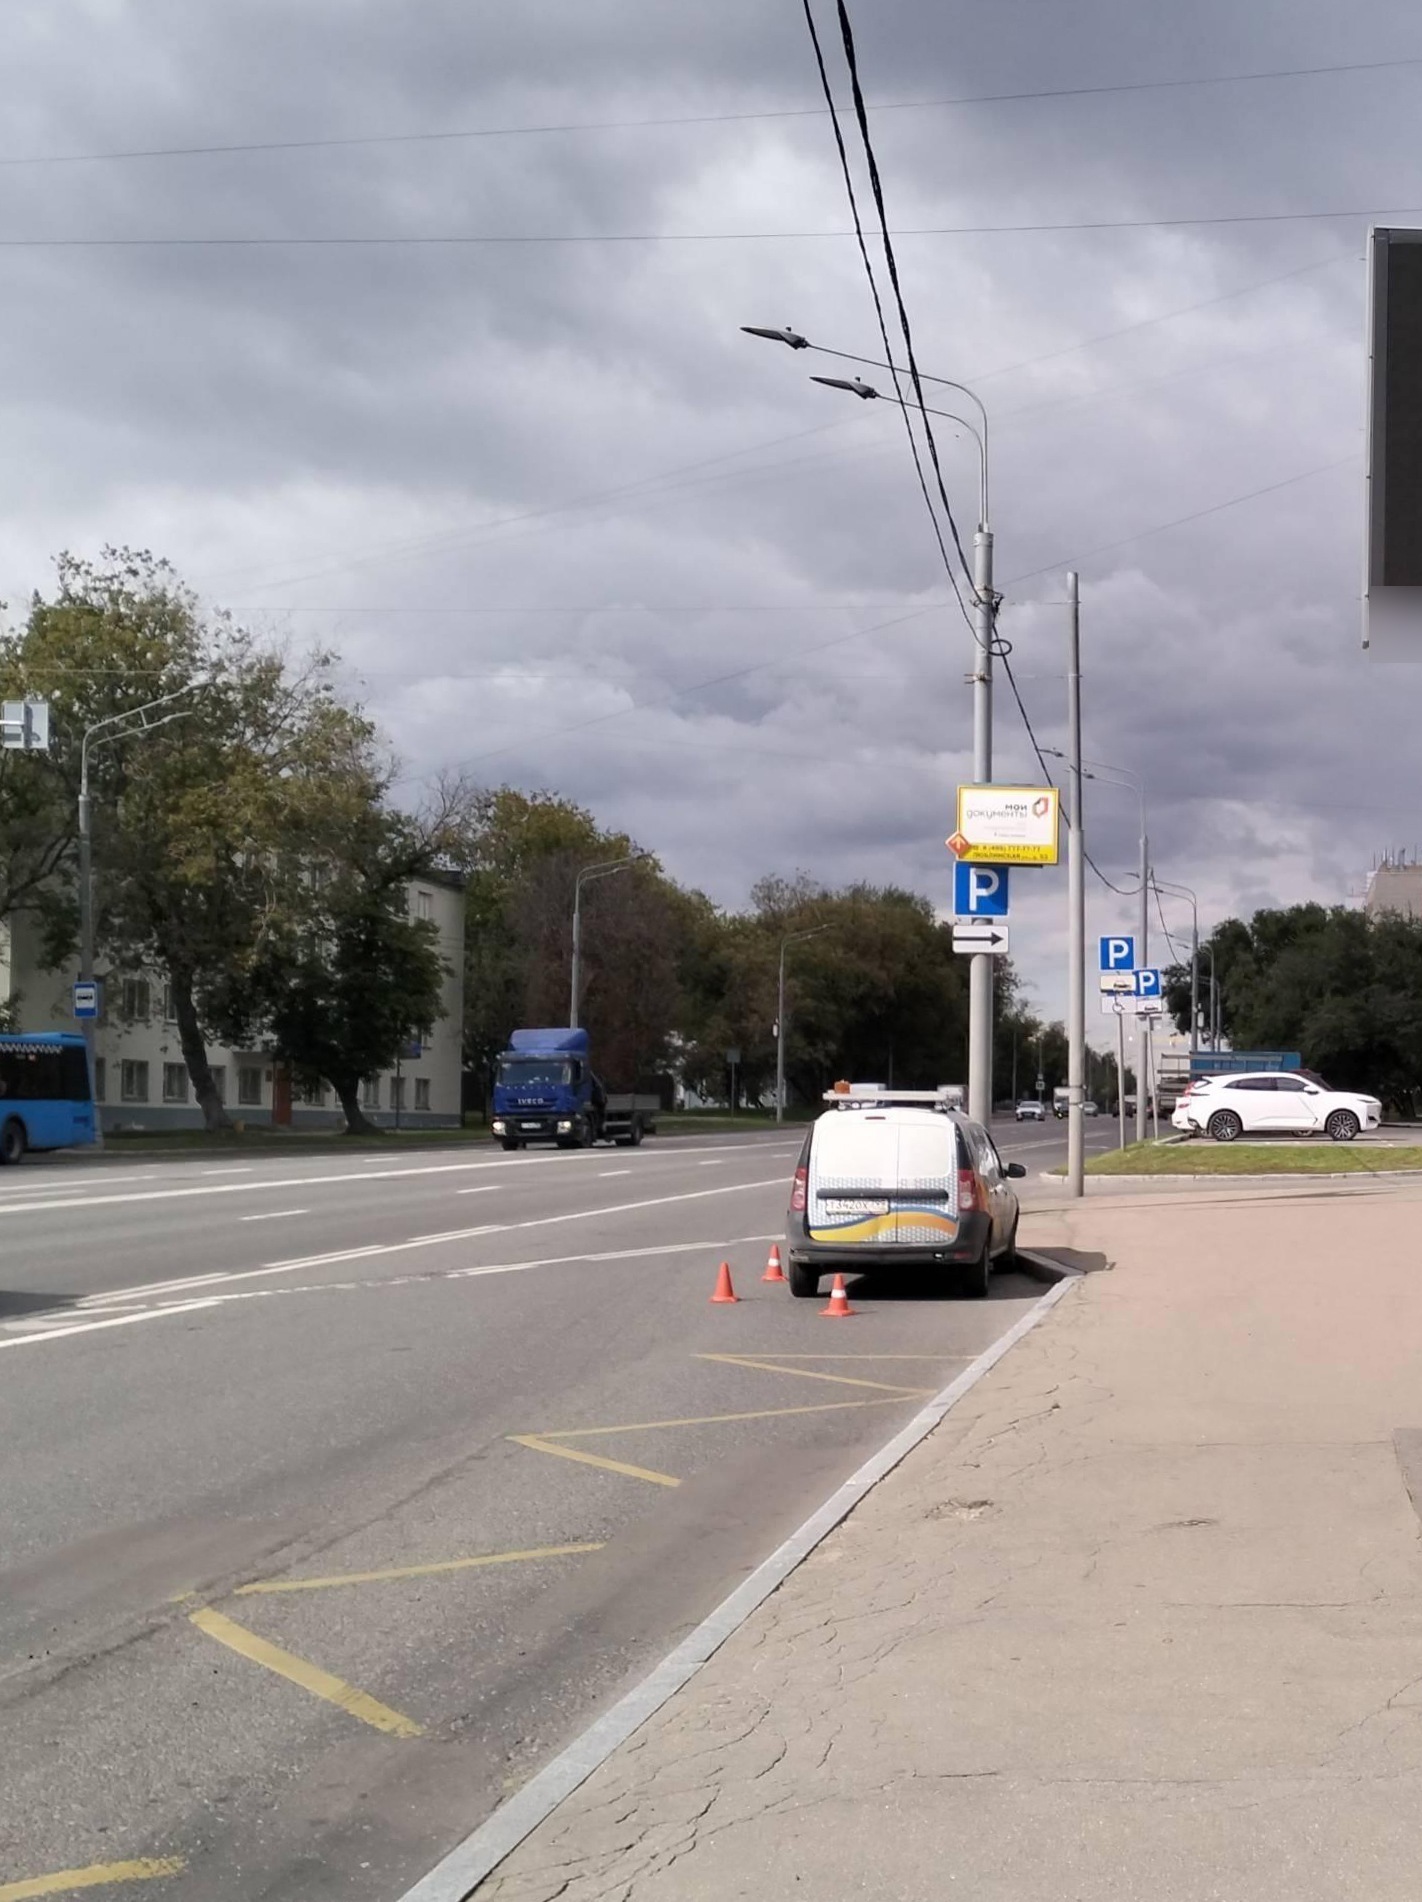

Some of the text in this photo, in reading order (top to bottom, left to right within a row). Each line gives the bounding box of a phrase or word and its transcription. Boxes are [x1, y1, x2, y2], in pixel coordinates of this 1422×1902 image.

[969, 867, 999, 911] P
[1108, 940, 1129, 968] P
[1138, 971, 1155, 995] P
[517, 1097, 544, 1105] IVECO
